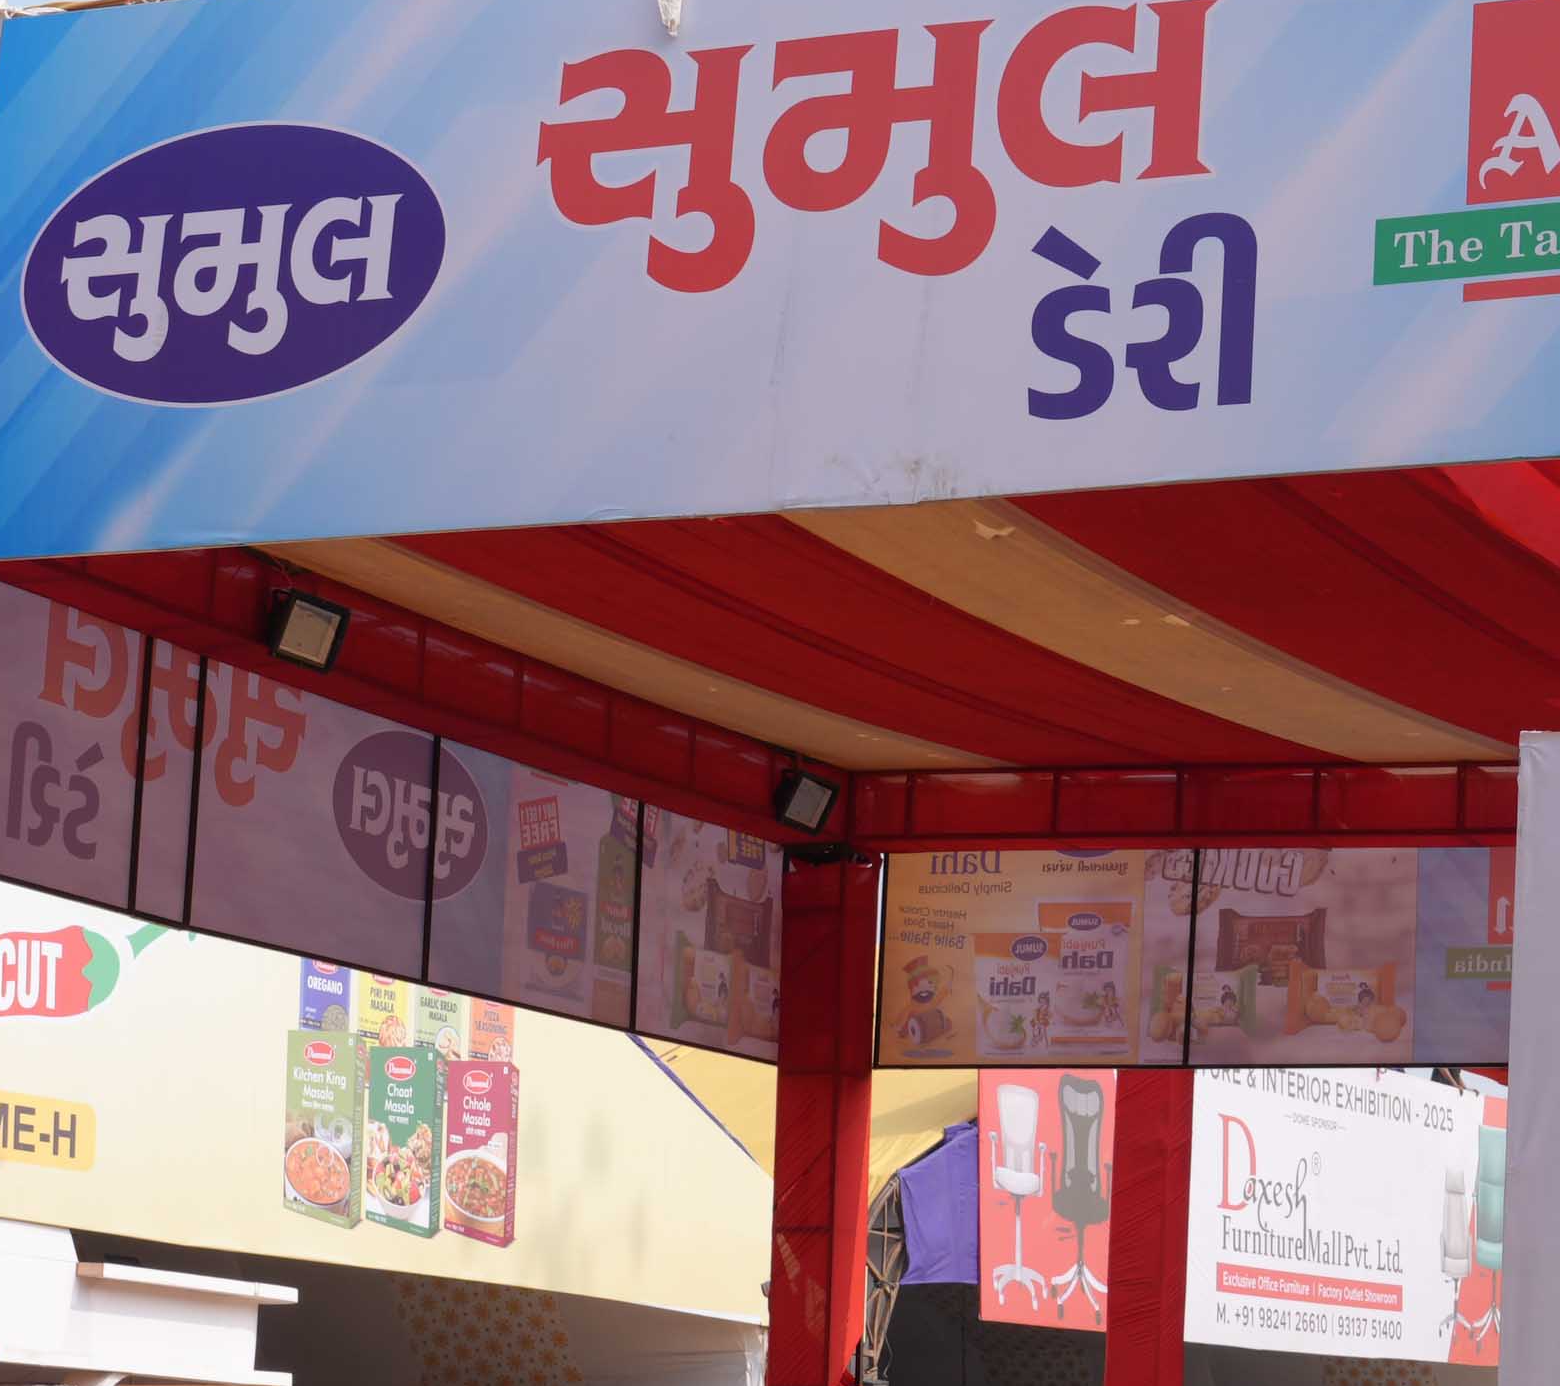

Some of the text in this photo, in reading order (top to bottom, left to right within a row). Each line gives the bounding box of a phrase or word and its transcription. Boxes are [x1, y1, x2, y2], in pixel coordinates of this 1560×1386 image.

[1393, 222, 1487, 272] The
[59, 190, 404, 360] સુમુલ
[1026, 211, 1259, 422] ડેરી
[307, 976, 343, 996] OREGANO
[384, 1099, 414, 1115] Masala
[462, 1113, 490, 1127] Masala
[1194, 1069, 1241, 1087] URE
[1262, 1069, 1331, 1106] INTERIOR
[1336, 1082, 1412, 1123] EXHIBITION
[1424, 1103, 1454, 1132] 2025
[1222, 1215, 1403, 1274] Furniture Mall Pvt. Ltd.
[1223, 1271, 1256, 1289] Exclusive
[1258, 1275, 1278, 1291] Office
[1280, 1278, 1310, 1295] Furniture
[1318, 1285, 1342, 1301] Factory
[1216, 1303, 1402, 1340] M. +91 98241 26610 93137 51400
